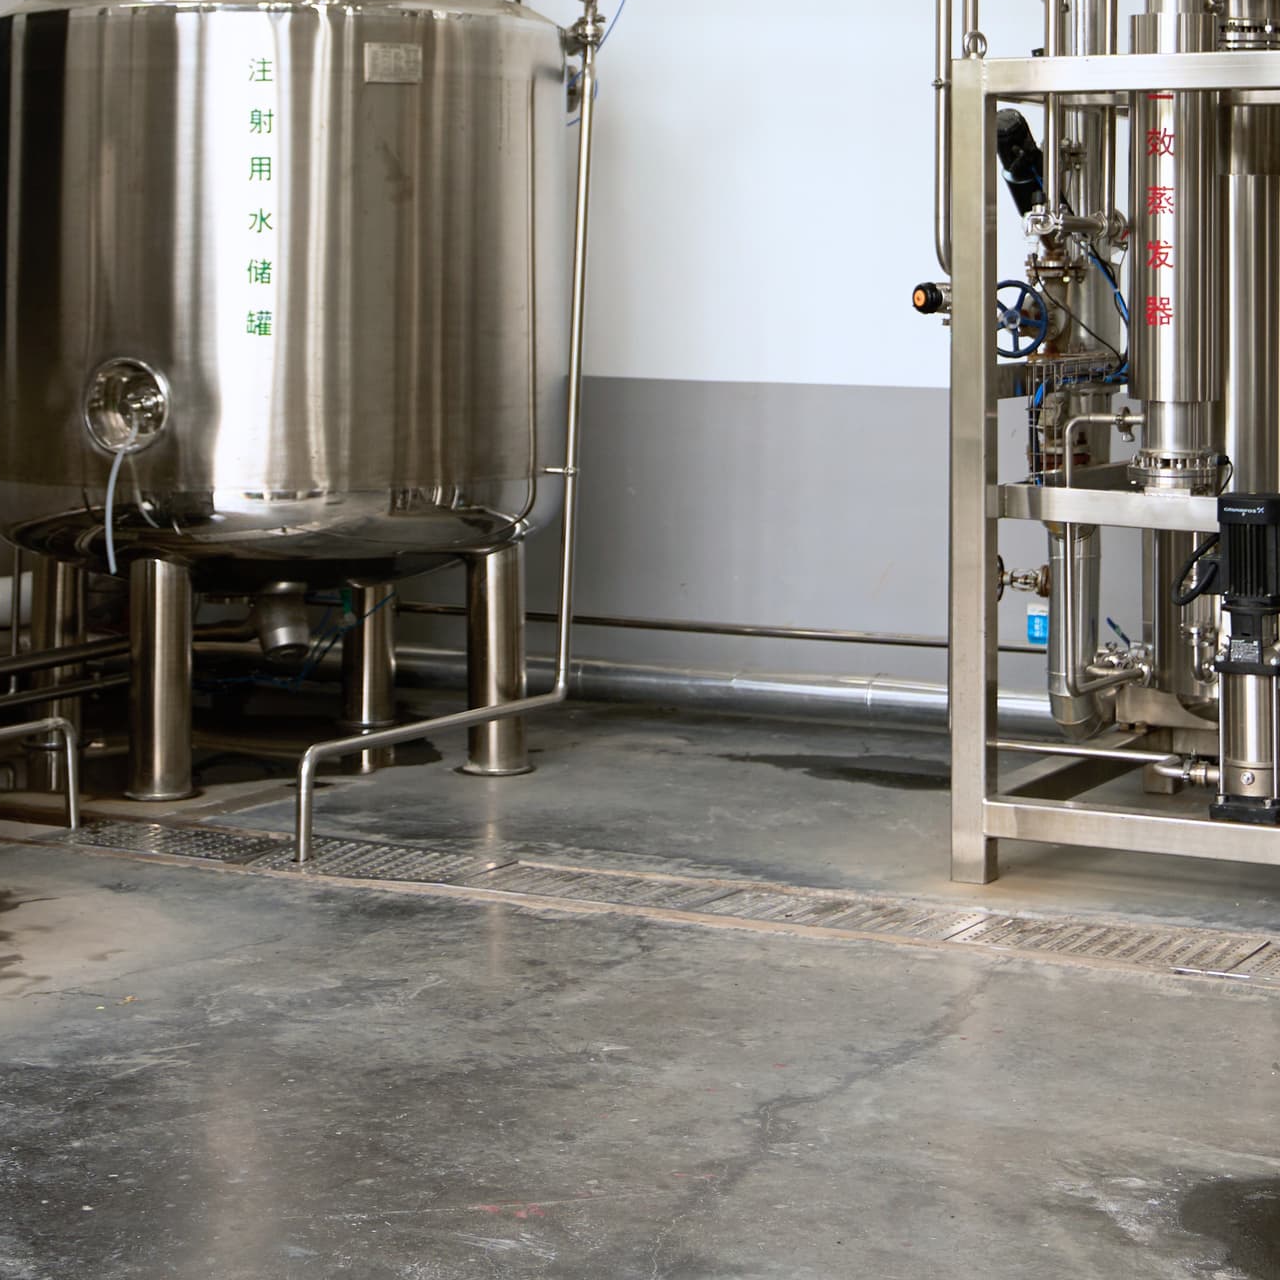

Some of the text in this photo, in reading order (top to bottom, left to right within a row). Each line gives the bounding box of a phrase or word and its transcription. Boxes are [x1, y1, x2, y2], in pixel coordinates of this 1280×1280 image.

[246, 57, 274, 337] 注射用水储罐
